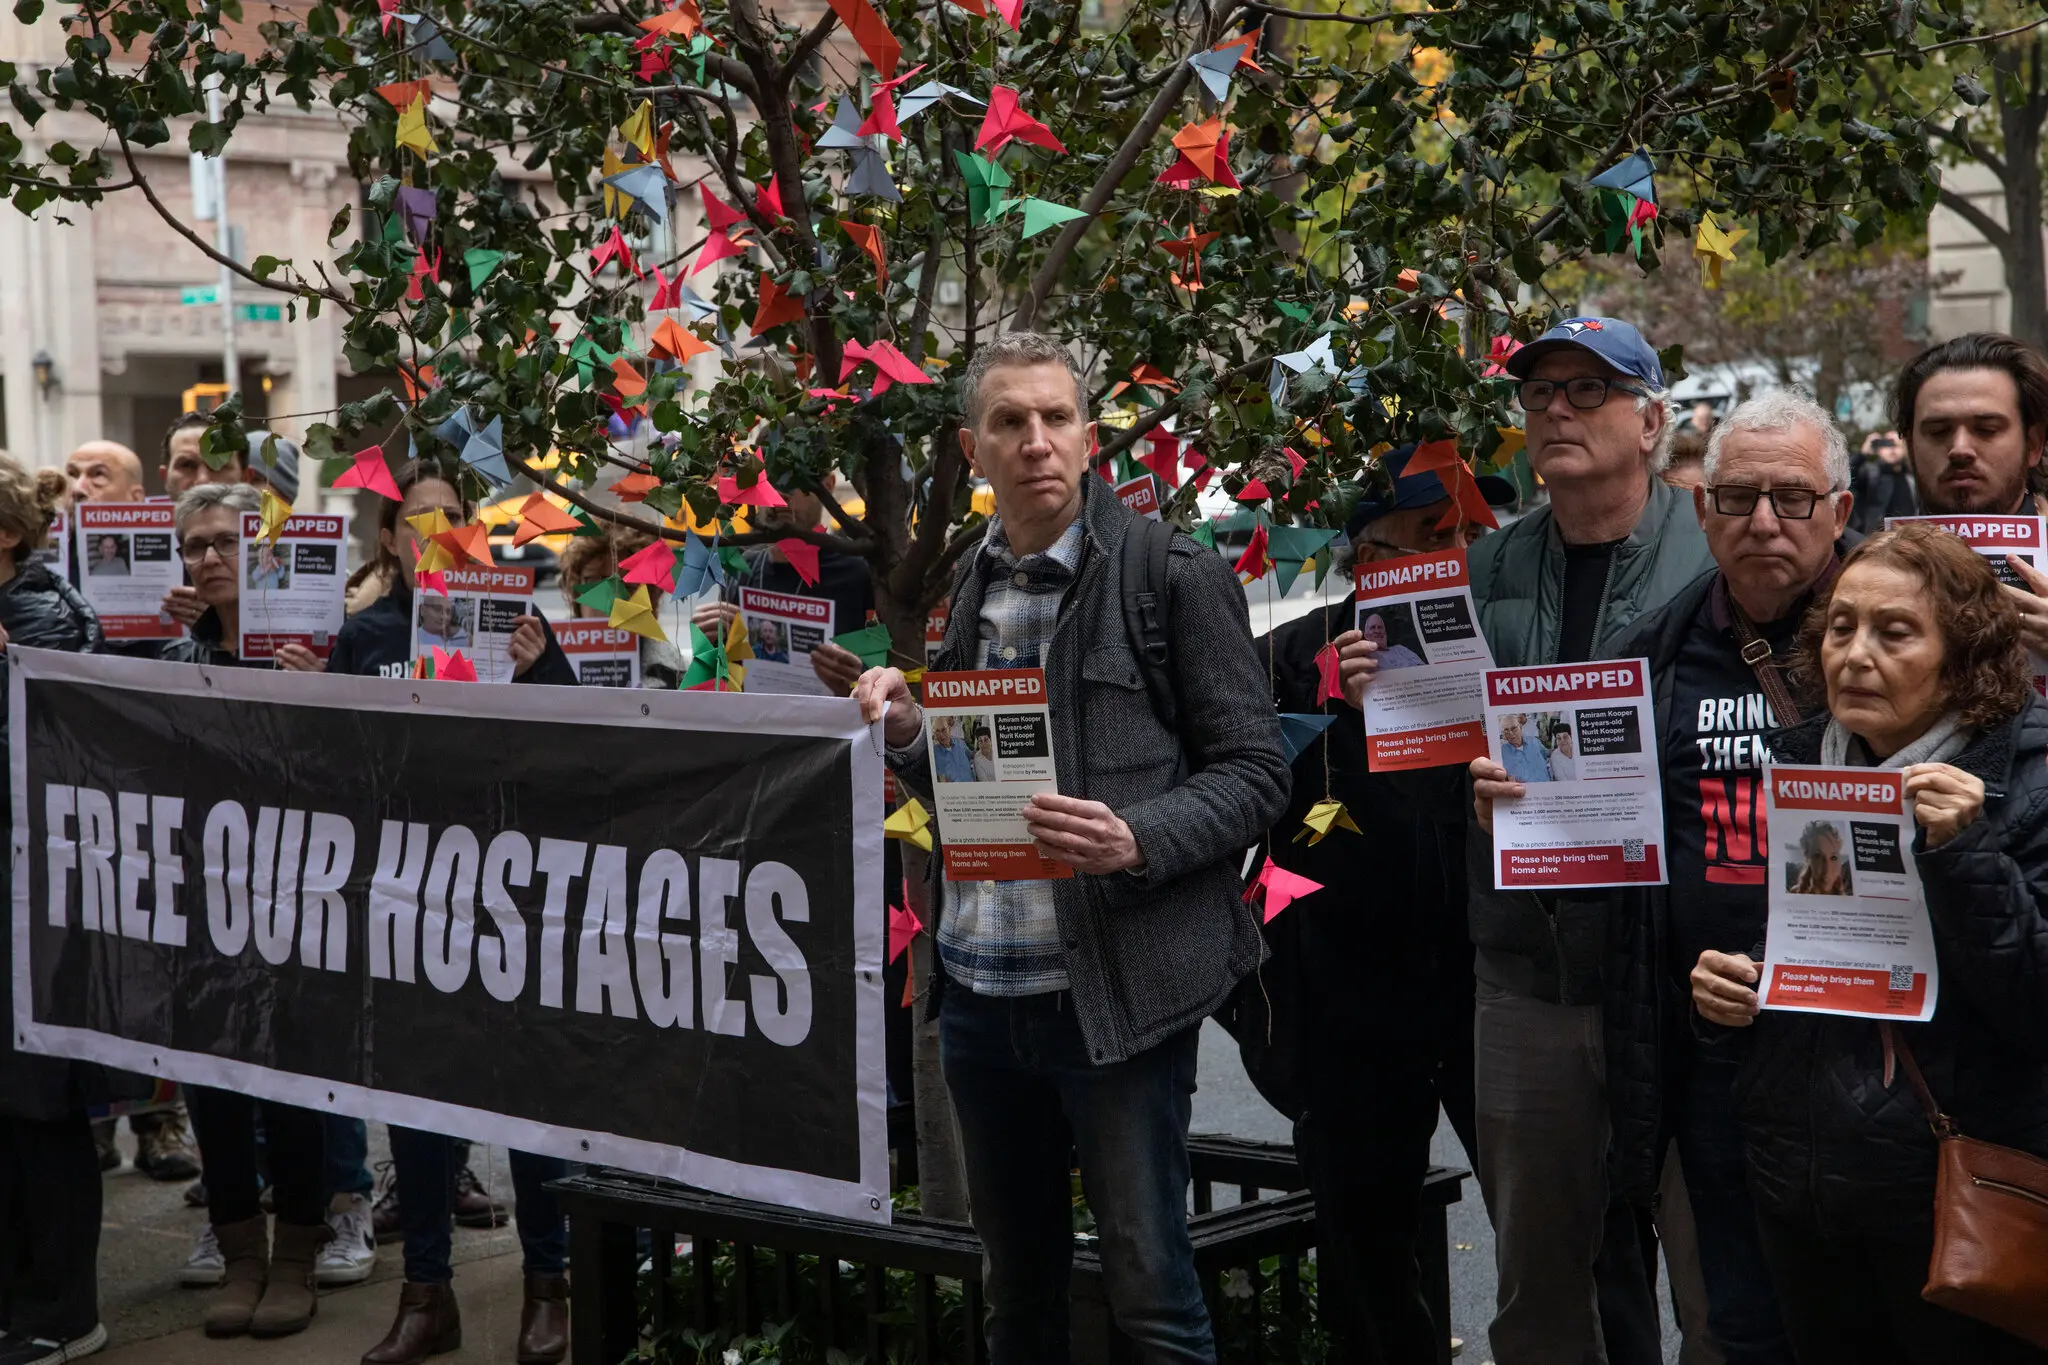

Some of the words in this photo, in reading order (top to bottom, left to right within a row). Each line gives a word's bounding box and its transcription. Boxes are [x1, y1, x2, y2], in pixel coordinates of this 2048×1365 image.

[85, 511, 171, 523] KIDNAPPED
[248, 519, 338, 533] KAPPED
[1939, 523, 2031, 538] NAPPED
[443, 570, 528, 588] DNAPPED
[1361, 560, 1460, 591] KIDNAPPED
[747, 594, 826, 617] KIDNAPPED
[1434, 602, 1454, 610] Samuel
[557, 629, 630, 646] APPED
[928, 677, 1040, 698] KIDNAPPED
[1495, 669, 1634, 696] KIDNAPPED
[1608, 710, 1633, 718] Kooper
[1394, 724, 1409, 732] photo
[1427, 720, 1444, 728] poster
[1581, 719, 1622, 728] 84-years-old
[1376, 739, 1403, 748] Please
[1406, 736, 1424, 745] help
[1425, 733, 1447, 741] bring
[1448, 730, 1469, 739] them
[1583, 736, 1624, 744] 79-years-old
[1377, 749, 1400, 758] home
[1403, 747, 1424, 755] alive.
[1778, 780, 1895, 803] KIDNAPPED
[950, 850, 972, 858] Please
[973, 850, 988, 860] help
[990, 850, 1008, 859] bring
[1511, 856, 1540, 864] Please
[1542, 855, 1561, 864] help
[1563, 854, 1585, 863] bring
[1511, 866, 1536, 874] home
[1538, 865, 1561, 874] alive.
[46, 784, 188, 947] FREE
[203, 800, 356, 973] OUR
[368, 819, 813, 1047] HOSTAGES
[1784, 956, 1798, 964] Take
[1781, 971, 1808, 981] Please
[1810, 974, 1828, 983] help
[1830, 975, 1851, 986] bring
[1854, 977, 1875, 985] them
[1779, 984, 1802, 992] home
[1804, 985, 1826, 994] alive.
